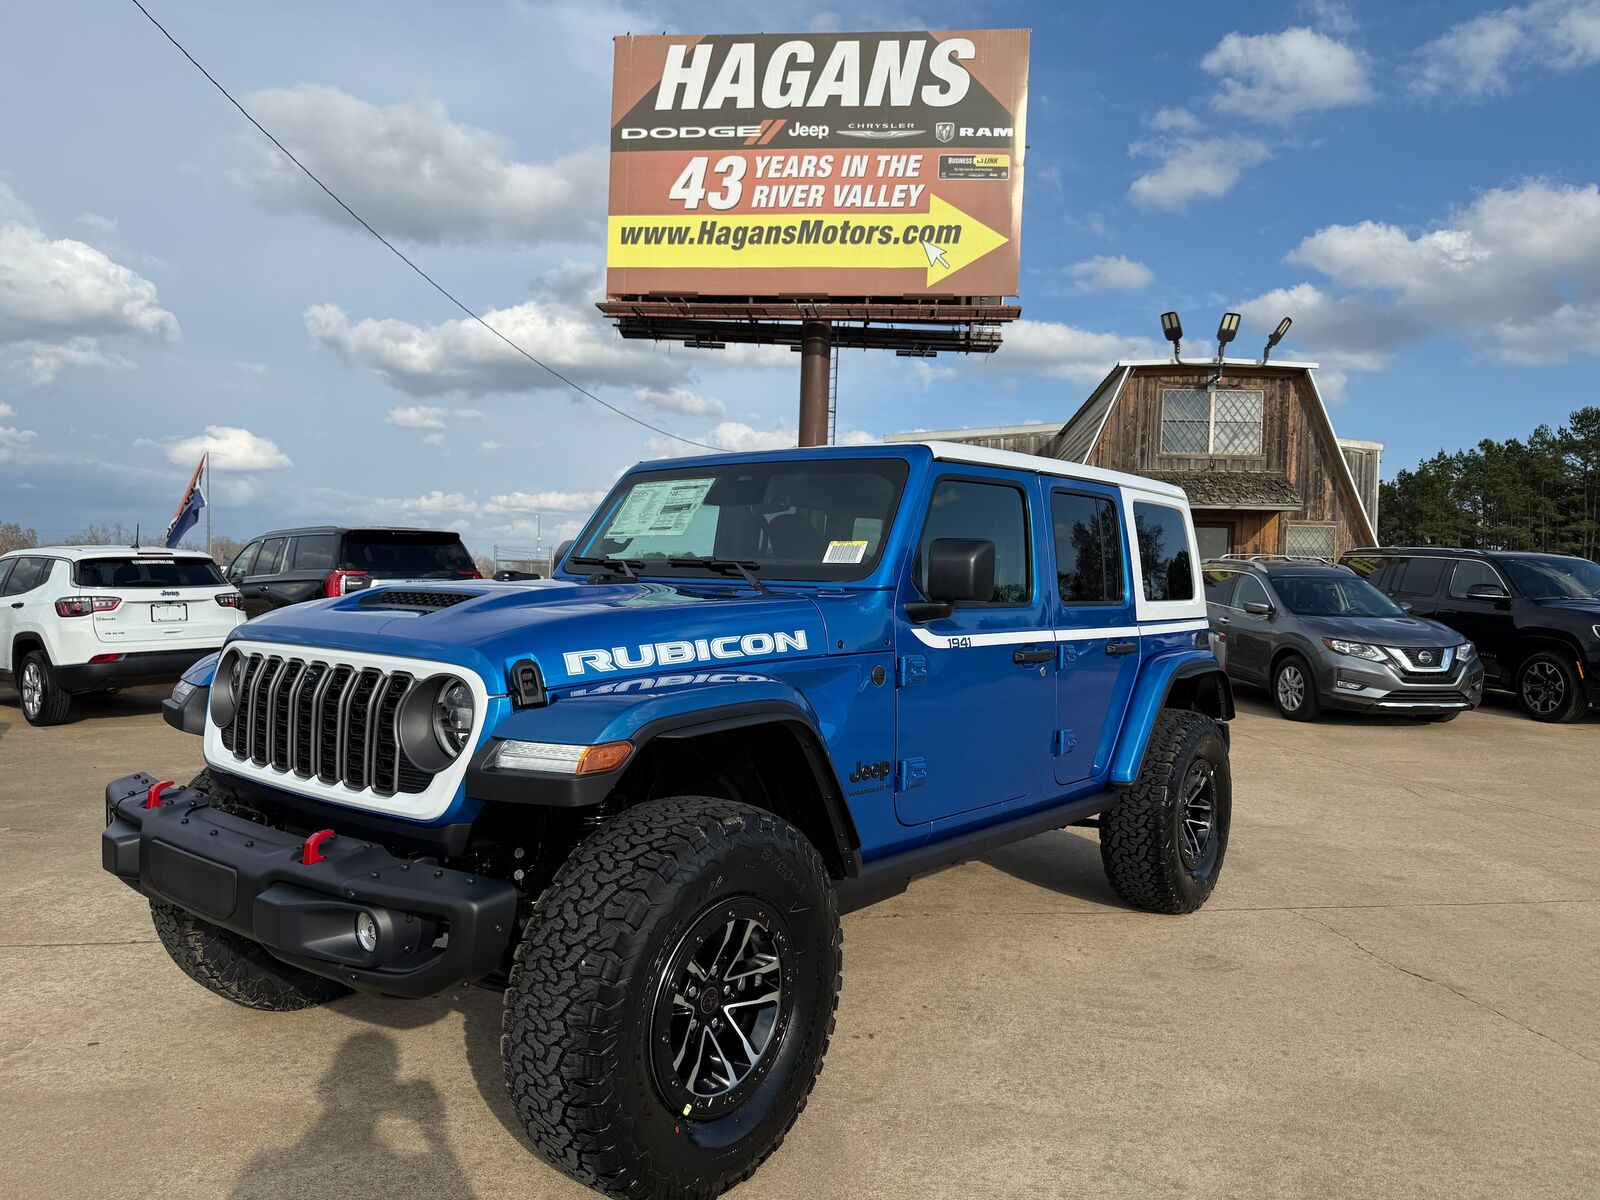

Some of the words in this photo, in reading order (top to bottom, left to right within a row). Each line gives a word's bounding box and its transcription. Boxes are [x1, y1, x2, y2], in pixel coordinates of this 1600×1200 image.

[654, 38, 976, 111] HAGANS
[621, 125, 762, 140] DODGE
[788, 122, 830, 139] Jeep
[959, 127, 1013, 137] RAM
[754, 155, 834, 179] YEARS
[840, 155, 870, 177] IN
[876, 155, 924, 177] THE
[948, 157, 972, 165] BUSINESS
[668, 155, 748, 210] 43
[751, 185, 826, 208] RIVER
[833, 184, 926, 207] VALLEY
[620, 220, 962, 250] www.HagansMotors.com
[562, 630, 808, 676] RUBICON
[947, 637, 972, 649] 1941
[849, 760, 891, 783] Jeep
